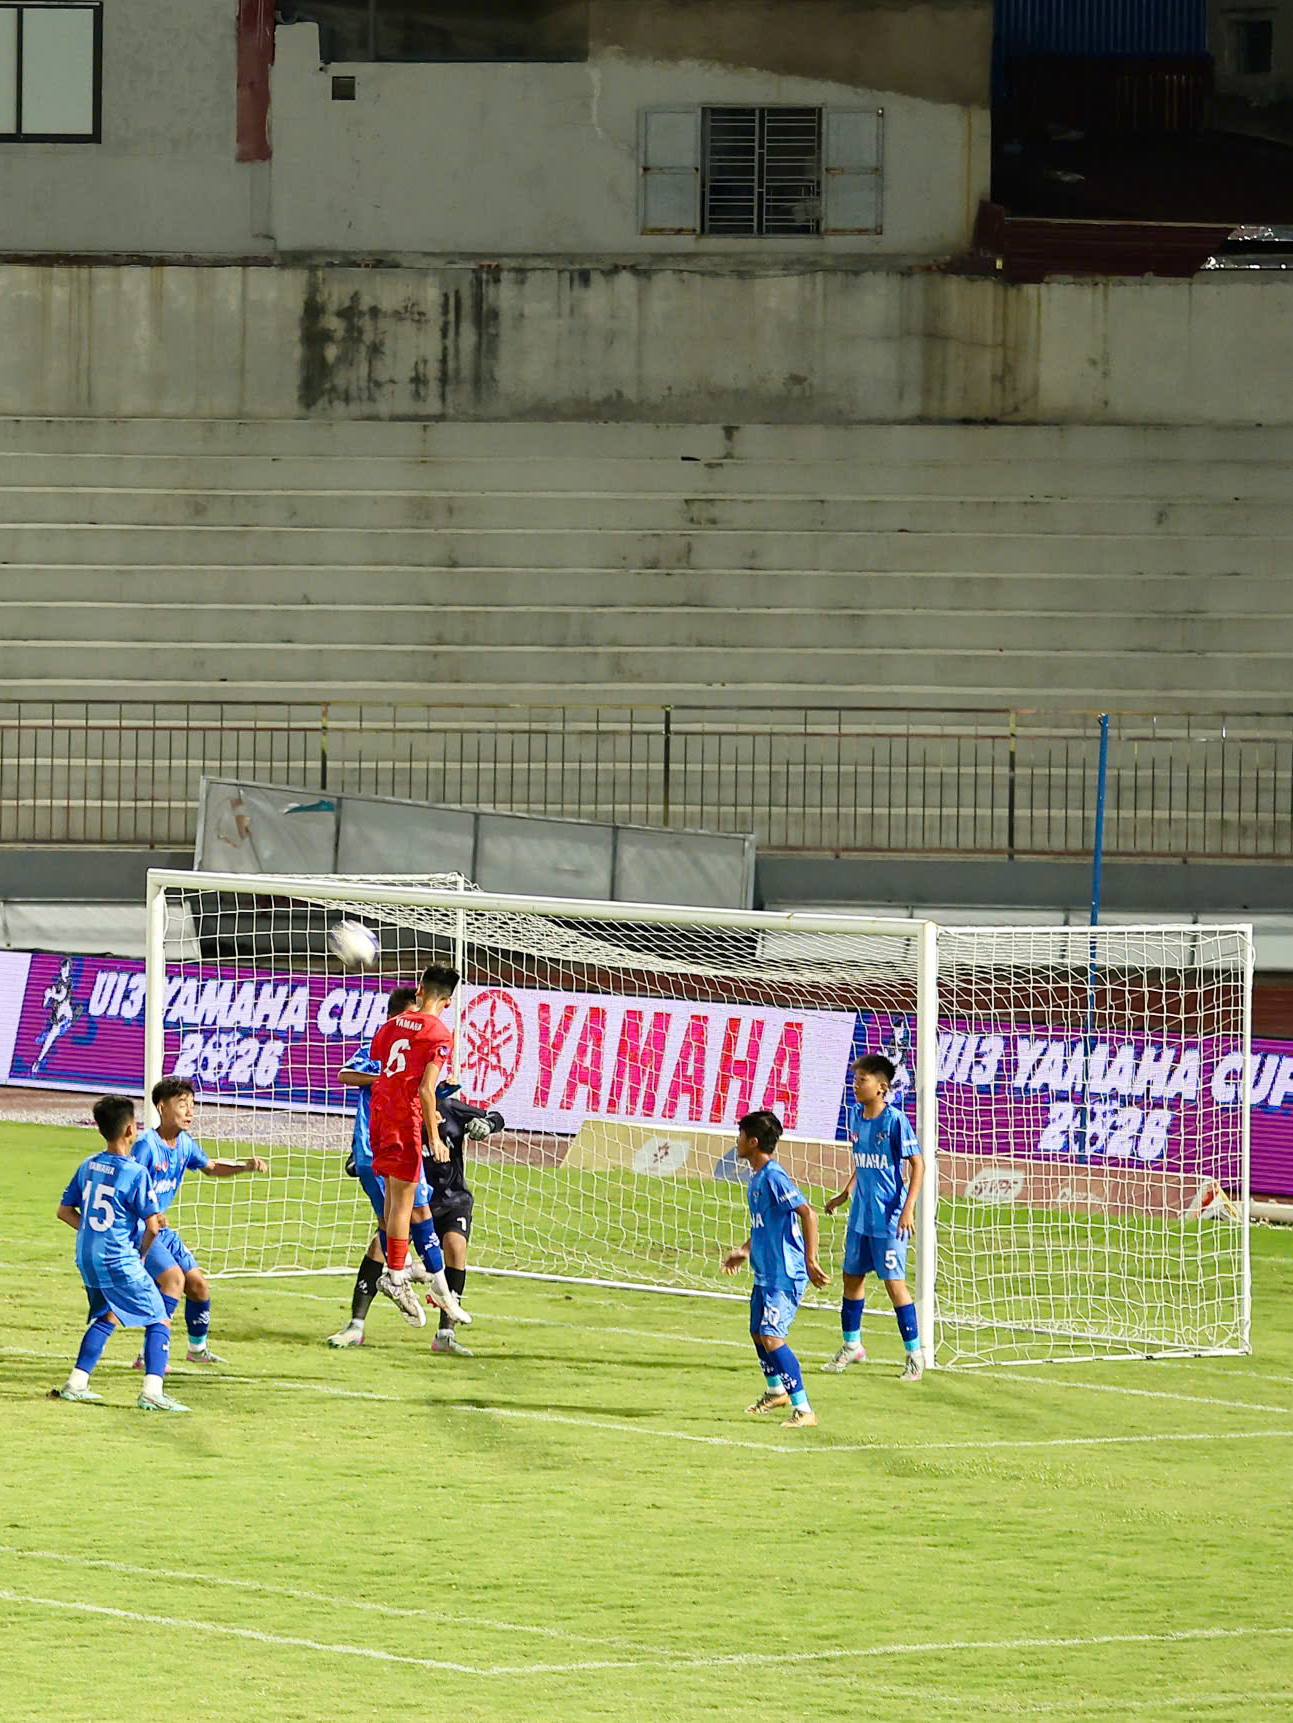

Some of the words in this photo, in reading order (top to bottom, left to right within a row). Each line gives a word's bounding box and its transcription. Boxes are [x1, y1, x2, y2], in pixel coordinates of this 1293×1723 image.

[88, 970, 147, 1018] U13
[383, 1038, 411, 1078] 6
[533, 1003, 804, 1130] YAMAHA
[82, 1180, 116, 1232] 15
[885, 1250, 897, 1269] 5
